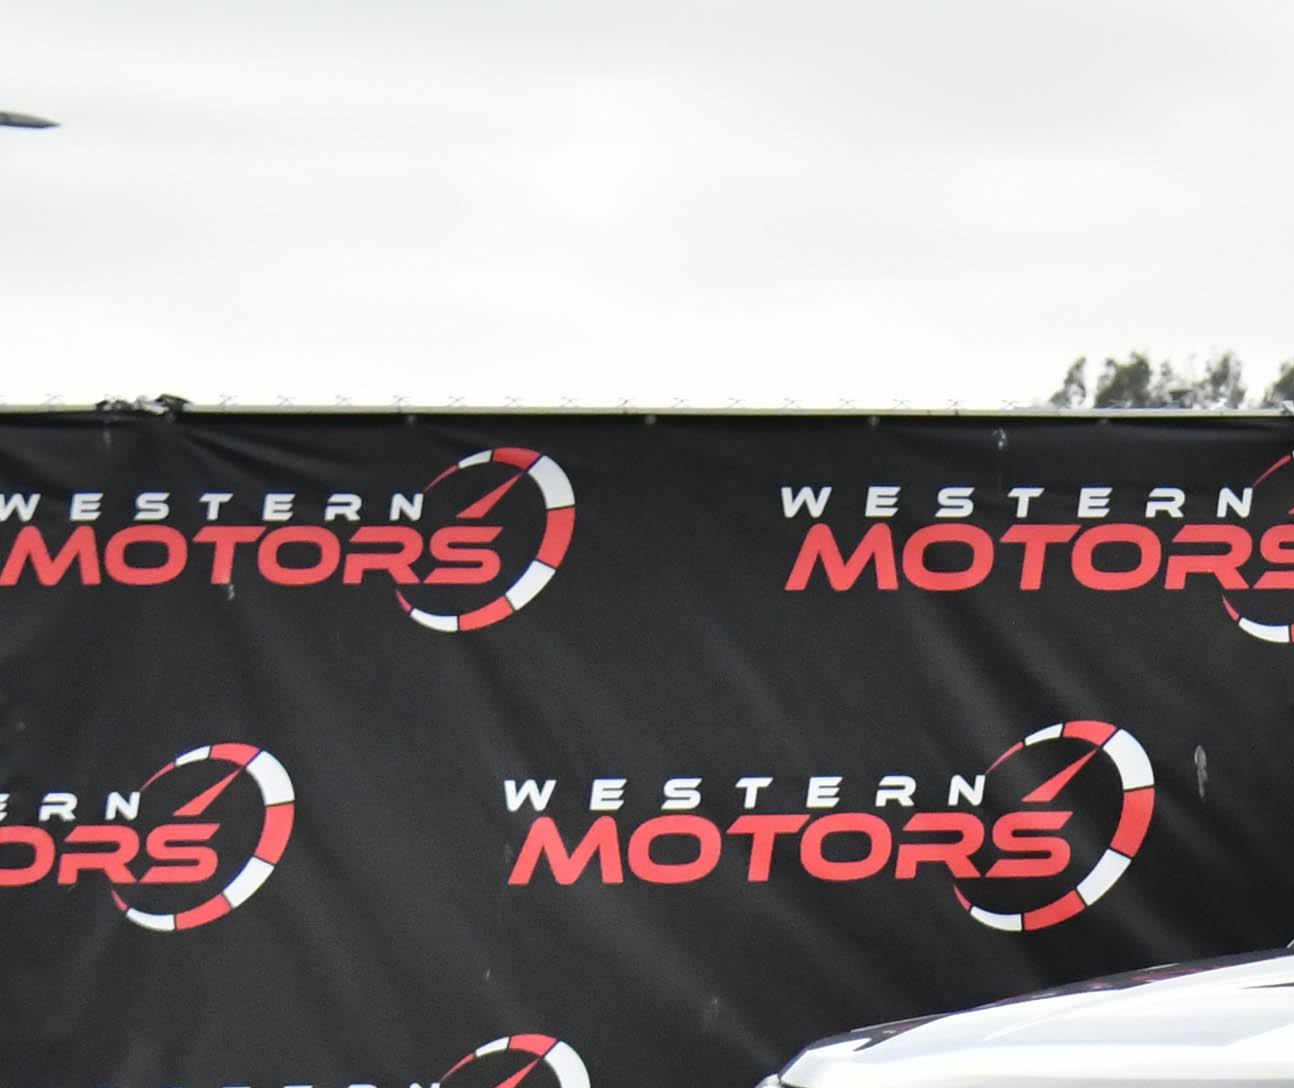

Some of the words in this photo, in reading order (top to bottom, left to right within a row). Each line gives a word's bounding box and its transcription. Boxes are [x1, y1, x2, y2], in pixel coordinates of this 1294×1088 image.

[0, 492, 424, 522] WESTERN
[781, 486, 1253, 518] WESTERN
[0, 524, 502, 586] MOTORS
[503, 774, 986, 812] WESTERN
[507, 811, 1073, 886] MOTORS
